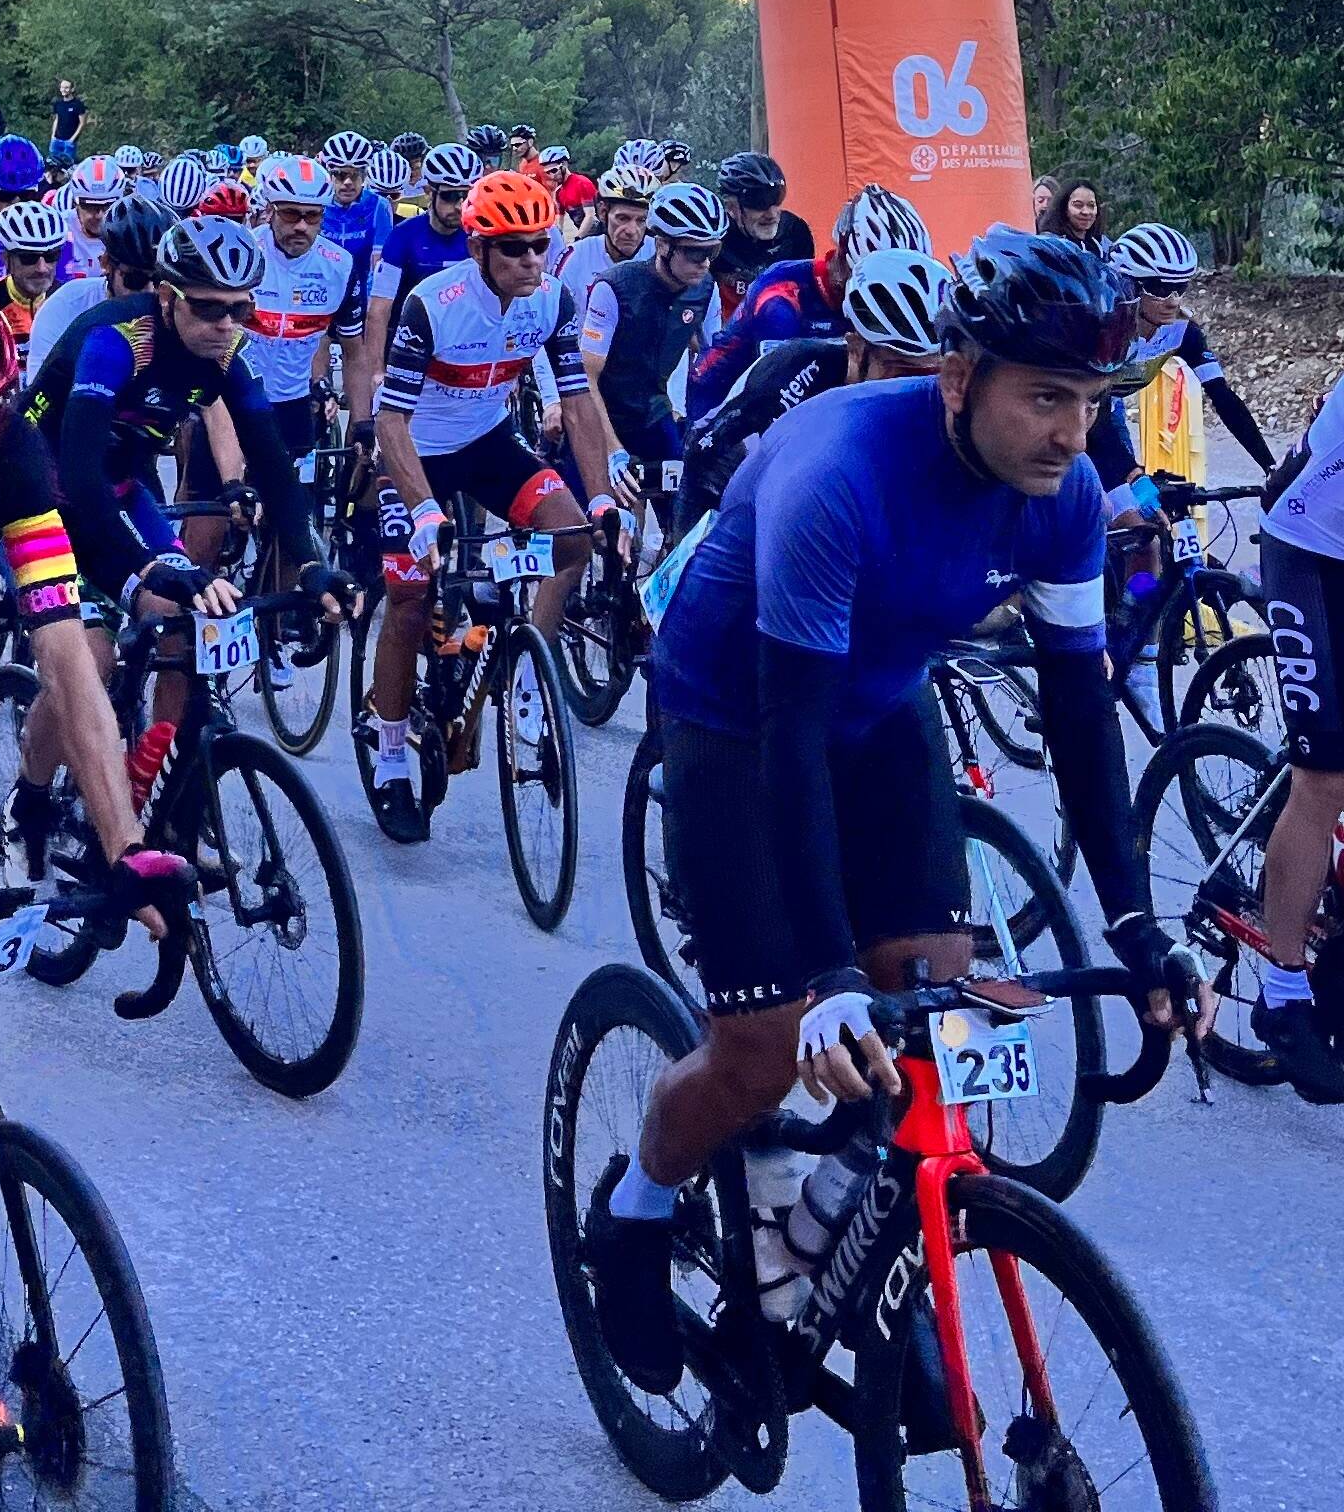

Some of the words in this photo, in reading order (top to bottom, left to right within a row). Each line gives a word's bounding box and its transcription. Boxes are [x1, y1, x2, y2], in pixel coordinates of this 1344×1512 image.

[892, 40, 989, 138] 06
[941, 158, 961, 169] DES
[510, 553, 539, 574] 10
[1176, 536, 1201, 558] 25
[208, 636, 252, 670] 101
[1266, 600, 1321, 713] CCRG
[956, 1043, 1030, 1096] 235
